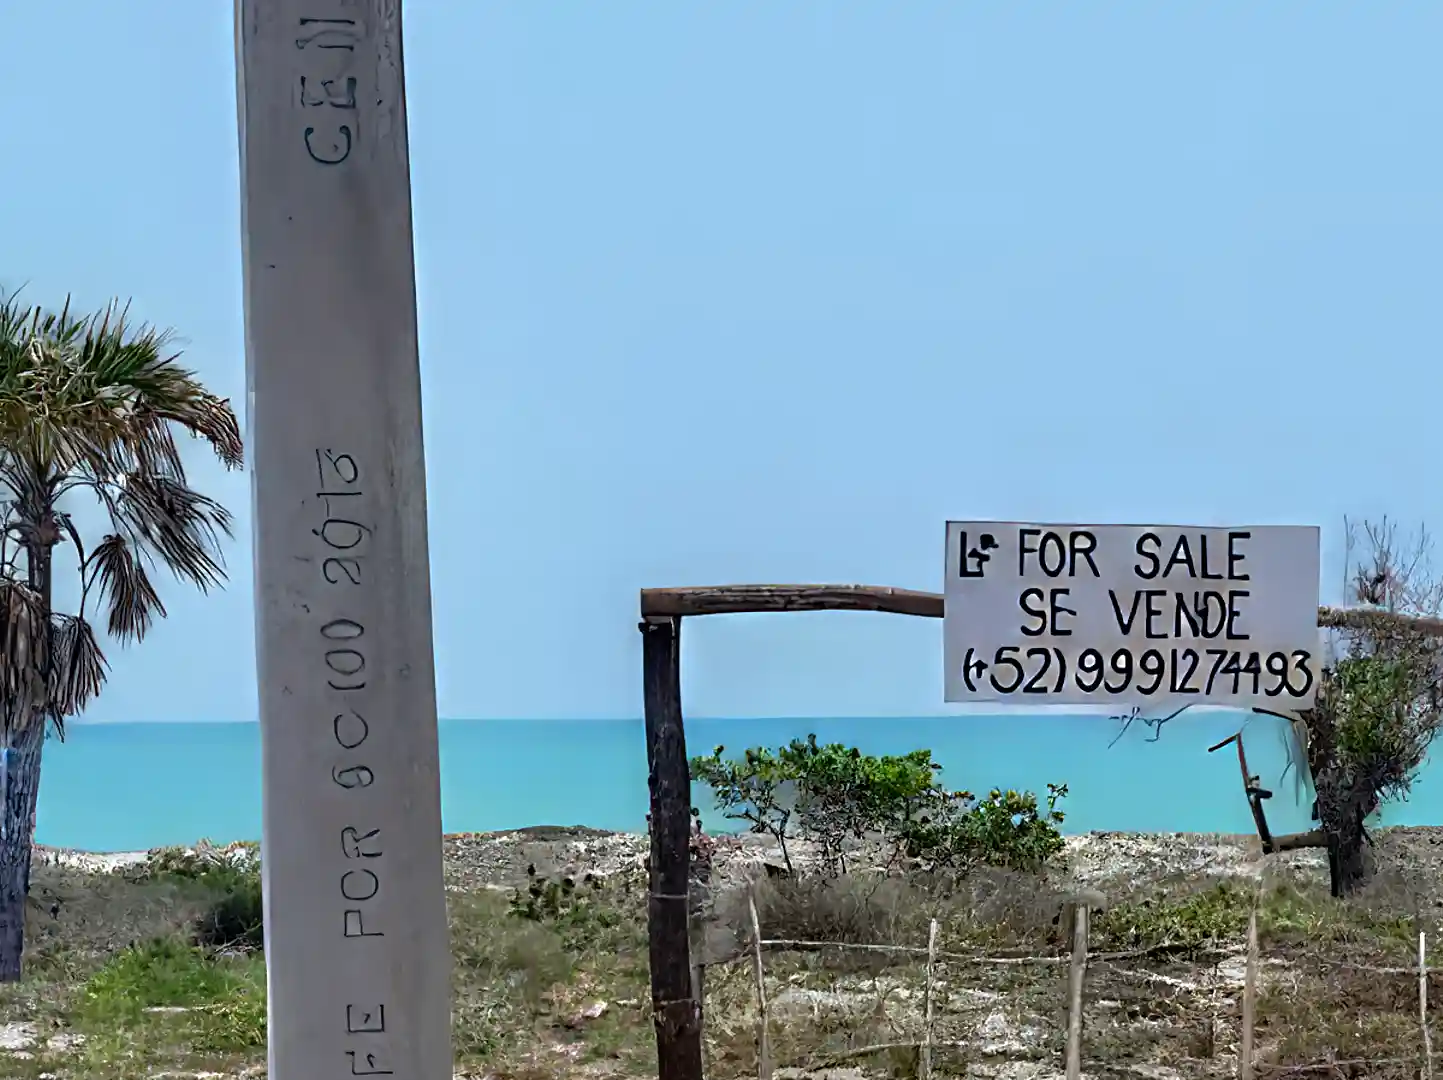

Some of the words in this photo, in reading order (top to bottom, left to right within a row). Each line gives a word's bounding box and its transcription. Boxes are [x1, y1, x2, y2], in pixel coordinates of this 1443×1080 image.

[1018, 529, 1100, 578] FOR
[1134, 531, 1251, 581] SALE
[1019, 587, 1077, 637] SE
[1108, 588, 1251, 640] VENDE
